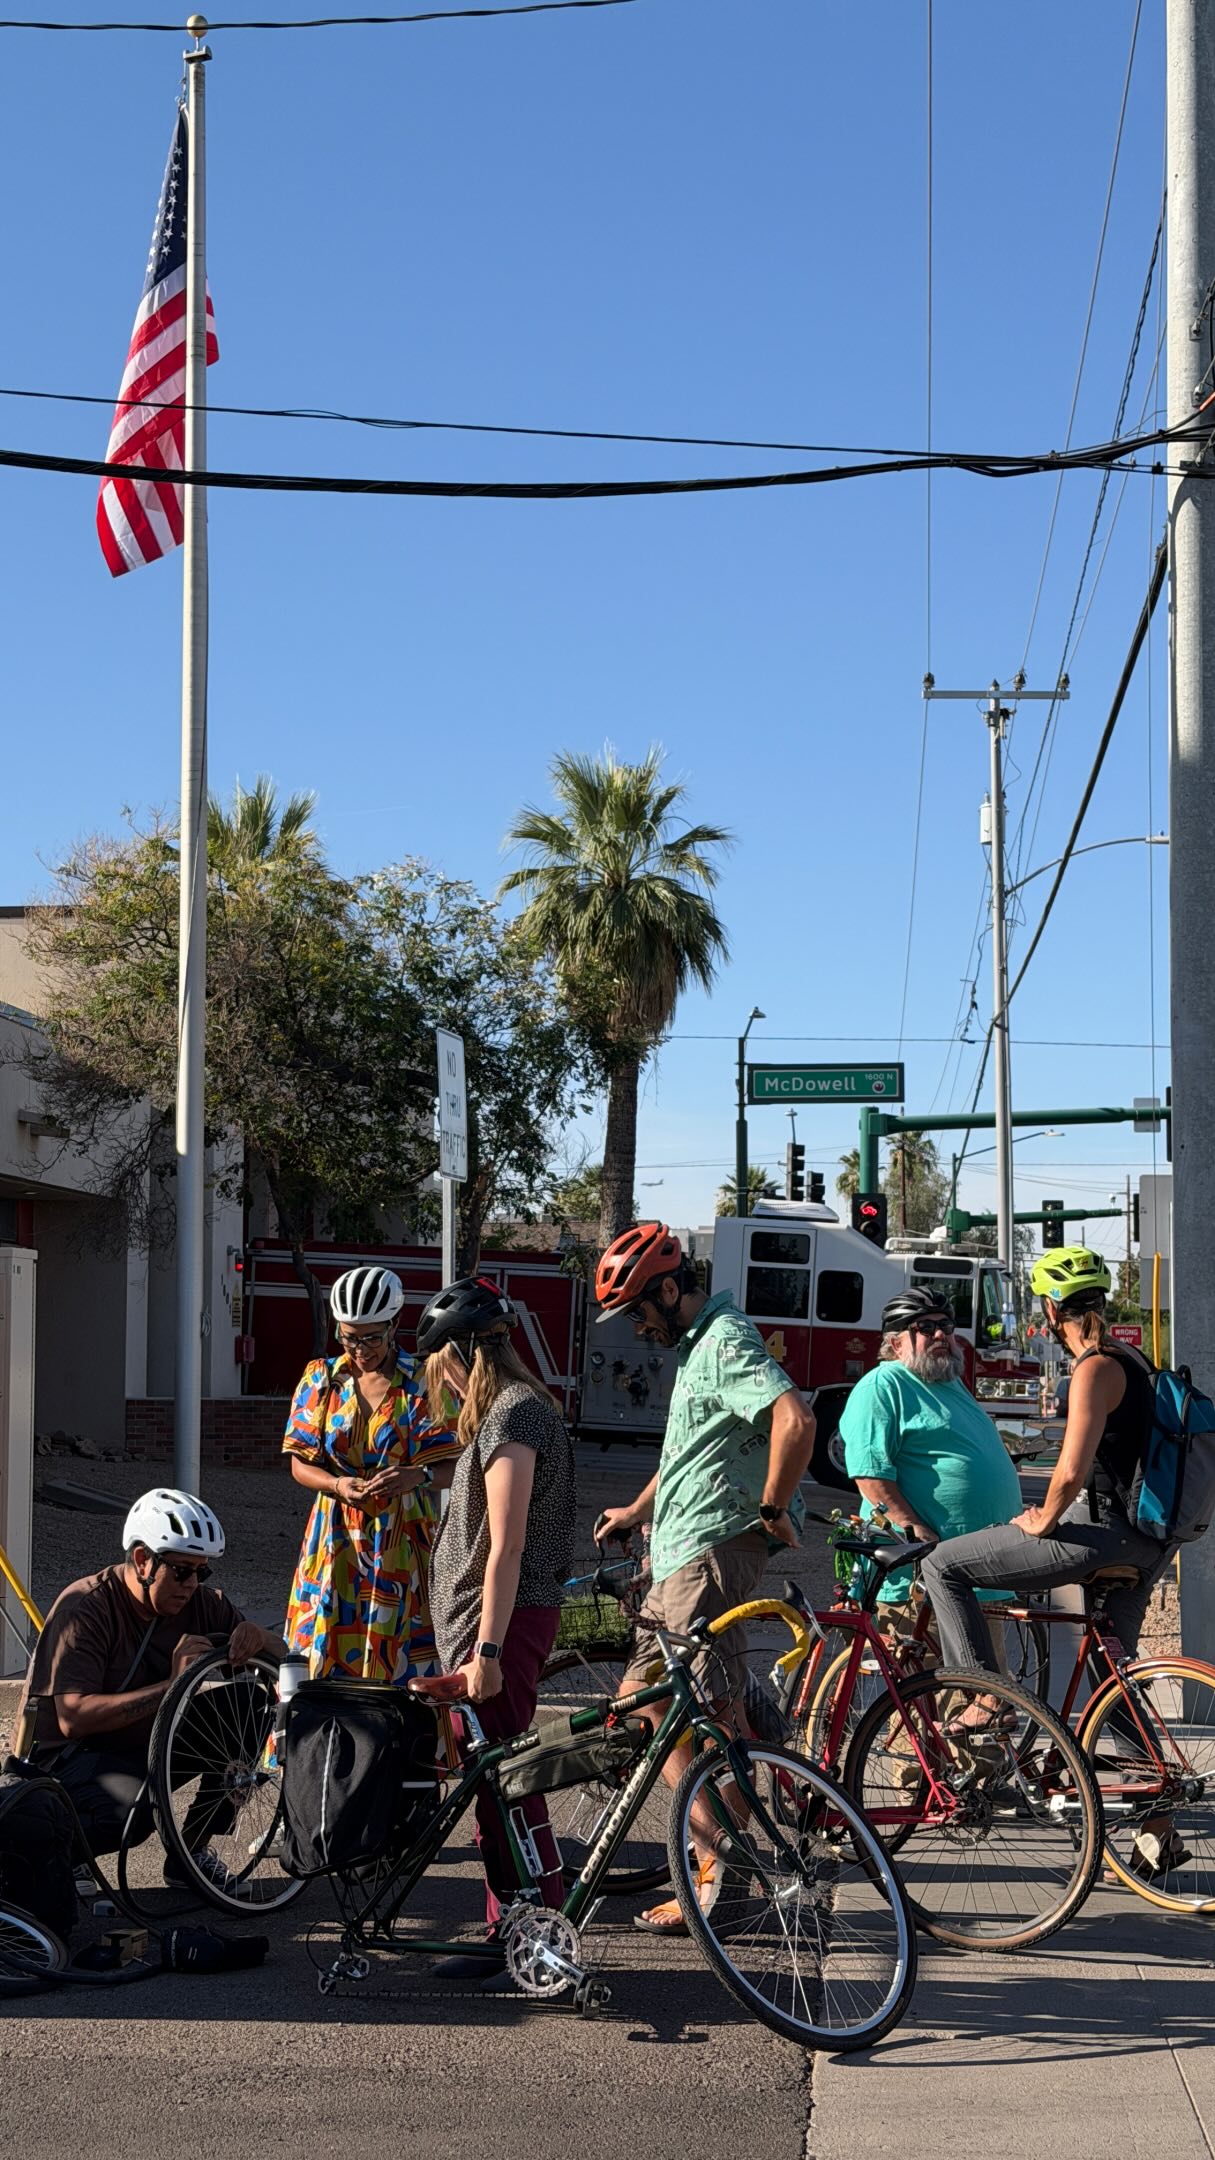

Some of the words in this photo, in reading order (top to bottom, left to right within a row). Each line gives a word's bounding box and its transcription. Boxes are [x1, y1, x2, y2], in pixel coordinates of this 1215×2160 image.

[446, 1050, 457, 1079] NO
[764, 1076, 857, 1092] McDowell
[864, 1073, 885, 1082] 1600
[886, 1073, 894, 1081] N
[442, 1130, 466, 1160] TRAFFIC
[765, 1330, 788, 1362] 4
[1114, 1328, 1139, 1336] WRONG
[579, 1756, 651, 1884] cannondale
